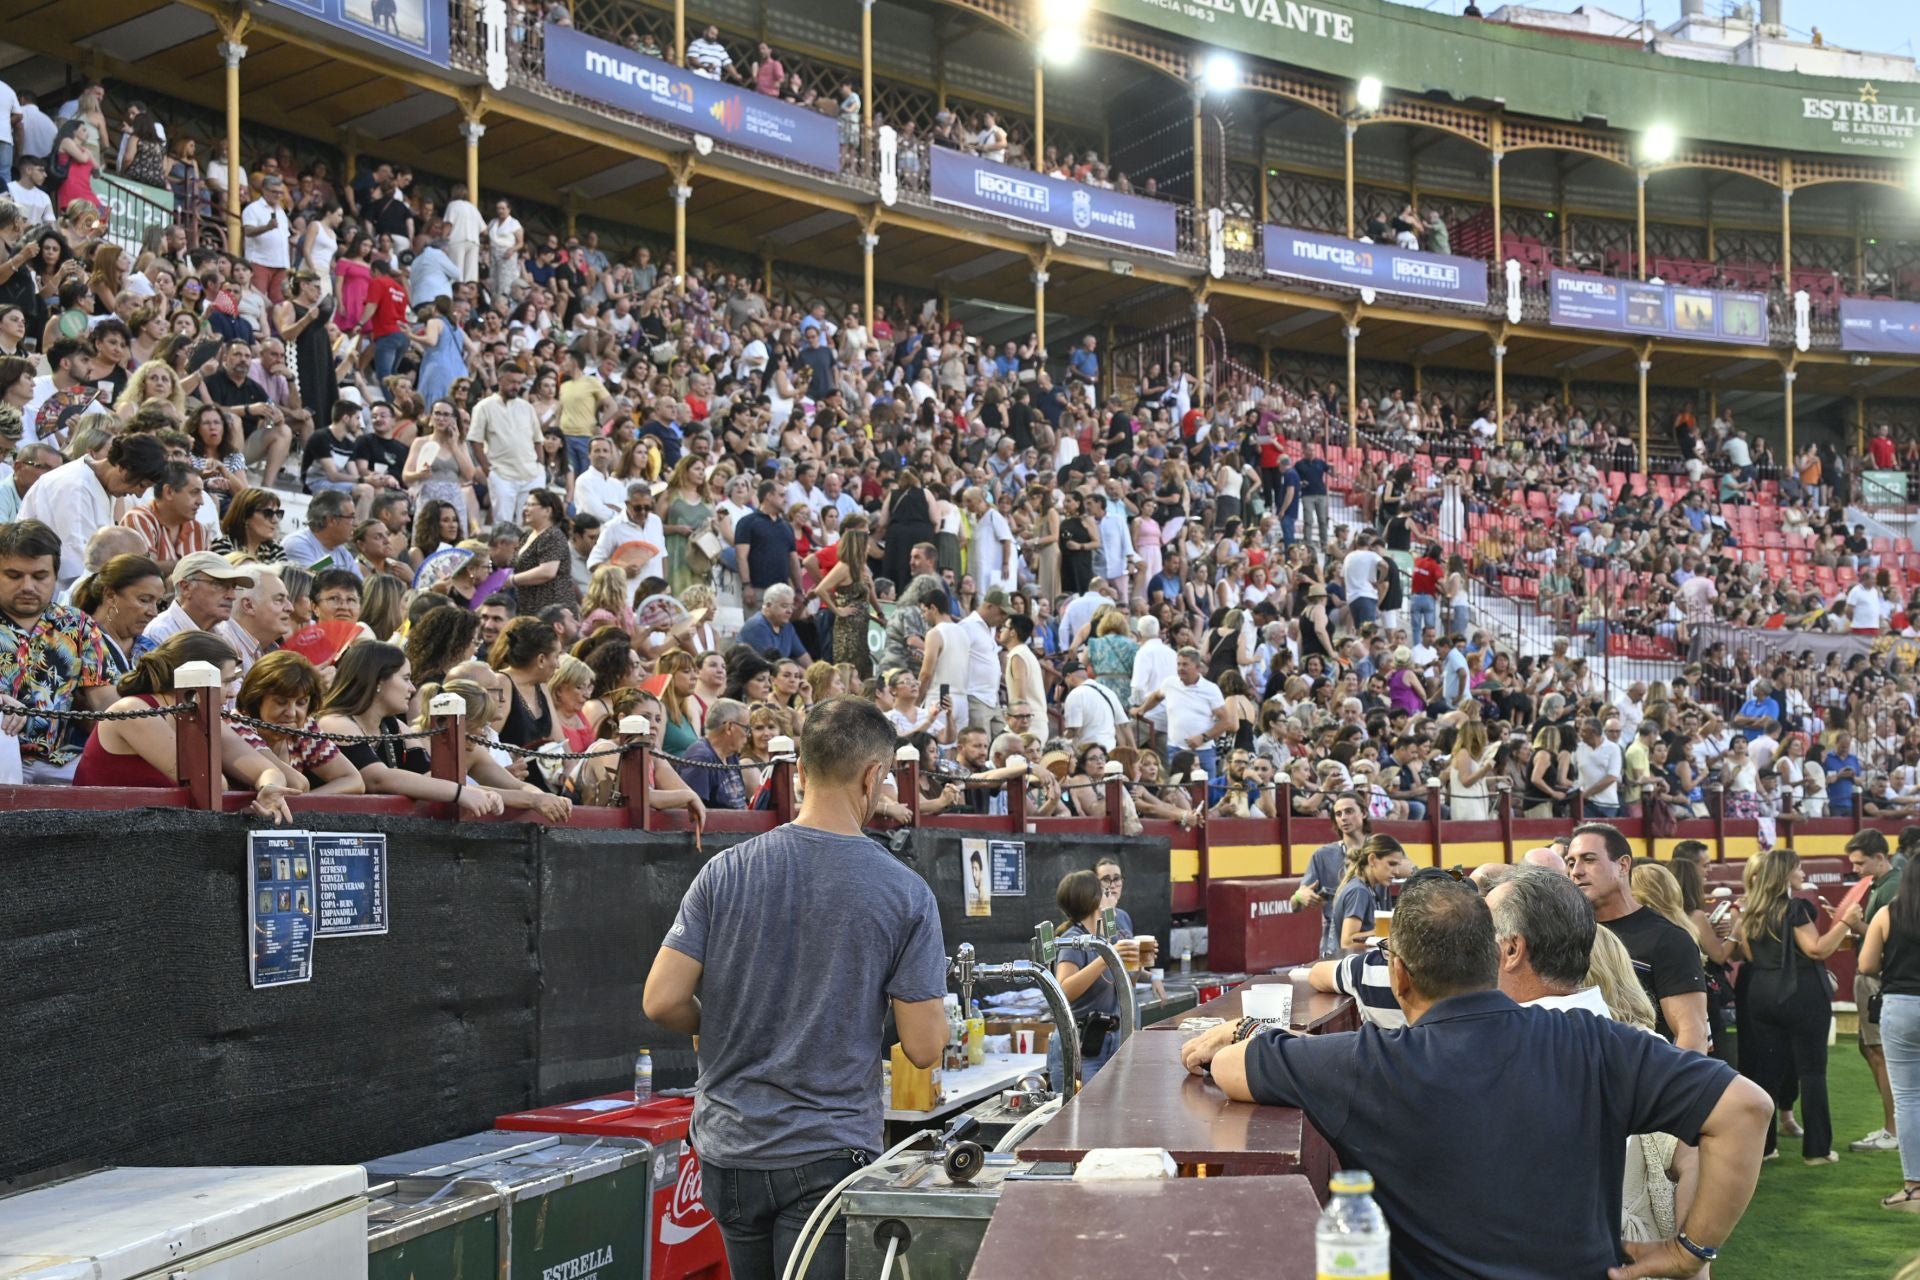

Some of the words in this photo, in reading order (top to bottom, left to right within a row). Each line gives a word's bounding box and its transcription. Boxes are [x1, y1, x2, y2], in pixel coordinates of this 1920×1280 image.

[1183, 4, 1215, 22] 1963
[1192, 0, 1354, 44] VANTE
[746, 122, 758, 134] DE
[760, 127, 793, 143] MURCIA
[1832, 120, 1850, 133] DE
[1852, 122, 1914, 138] LEVANTE
[319, 848, 334, 857] VASO
[334, 847, 370, 857] REUTILIZABLE
[319, 856, 335, 865] AGUA
[320, 865, 347, 874] REFRESCO
[320, 874, 344, 883] CERVEZA
[320, 883, 335, 892] TINTO
[335, 882, 344, 891] DE
[344, 881, 365, 891] VERANO
[320, 891, 336, 900] COPA
[320, 900, 336, 909] COPA
[339, 899, 354, 908] BURN
[1251, 902, 1258, 919] P
[1259, 899, 1295, 917] NACIONA
[321, 908, 358, 918] EMPANADILLA
[321, 916, 352, 926] BOCADILLO
[542, 1244, 614, 1280] ESTRELLA
